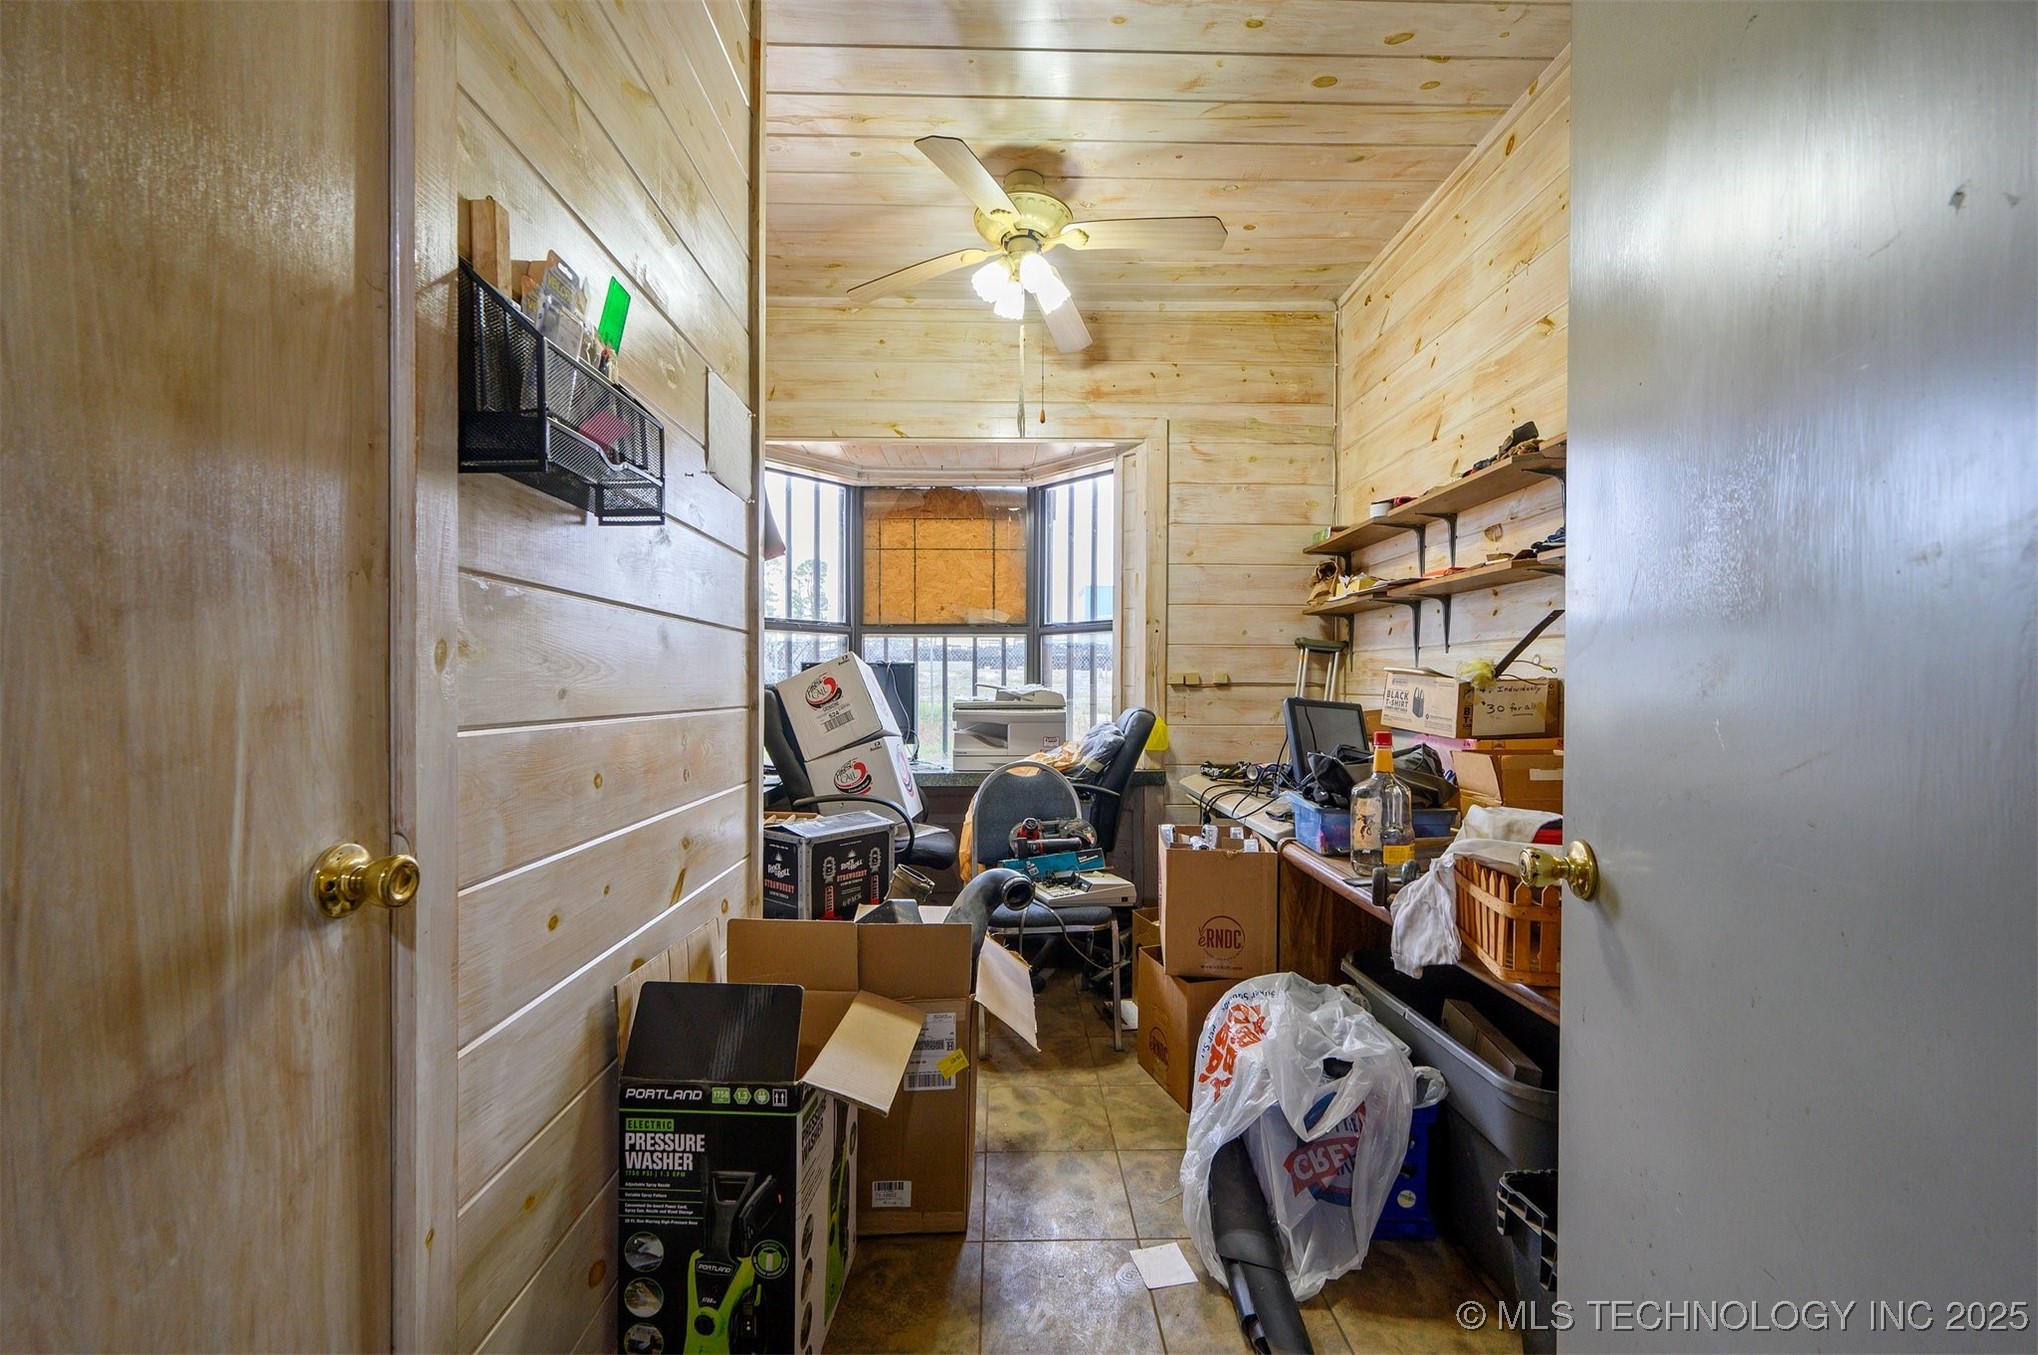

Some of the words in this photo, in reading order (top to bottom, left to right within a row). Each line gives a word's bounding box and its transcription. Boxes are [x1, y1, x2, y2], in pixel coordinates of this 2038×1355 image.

[1386, 690, 1410, 701] BLACK
[1385, 699, 1409, 708] T-SHIRT
[1509, 703, 1523, 712] for
[836, 869, 867, 882] STRAWBERRY
[764, 878, 795, 894] STRAWBERRY
[626, 1088, 703, 1100] PORTLAND
[737, 1090, 748, 1099] 1.3
[628, 1119, 672, 1130] ELECTRIC
[625, 1132, 705, 1152] PRESSURE
[625, 1151, 693, 1171] WASHER
[698, 1263, 731, 1274] PORTLAND
